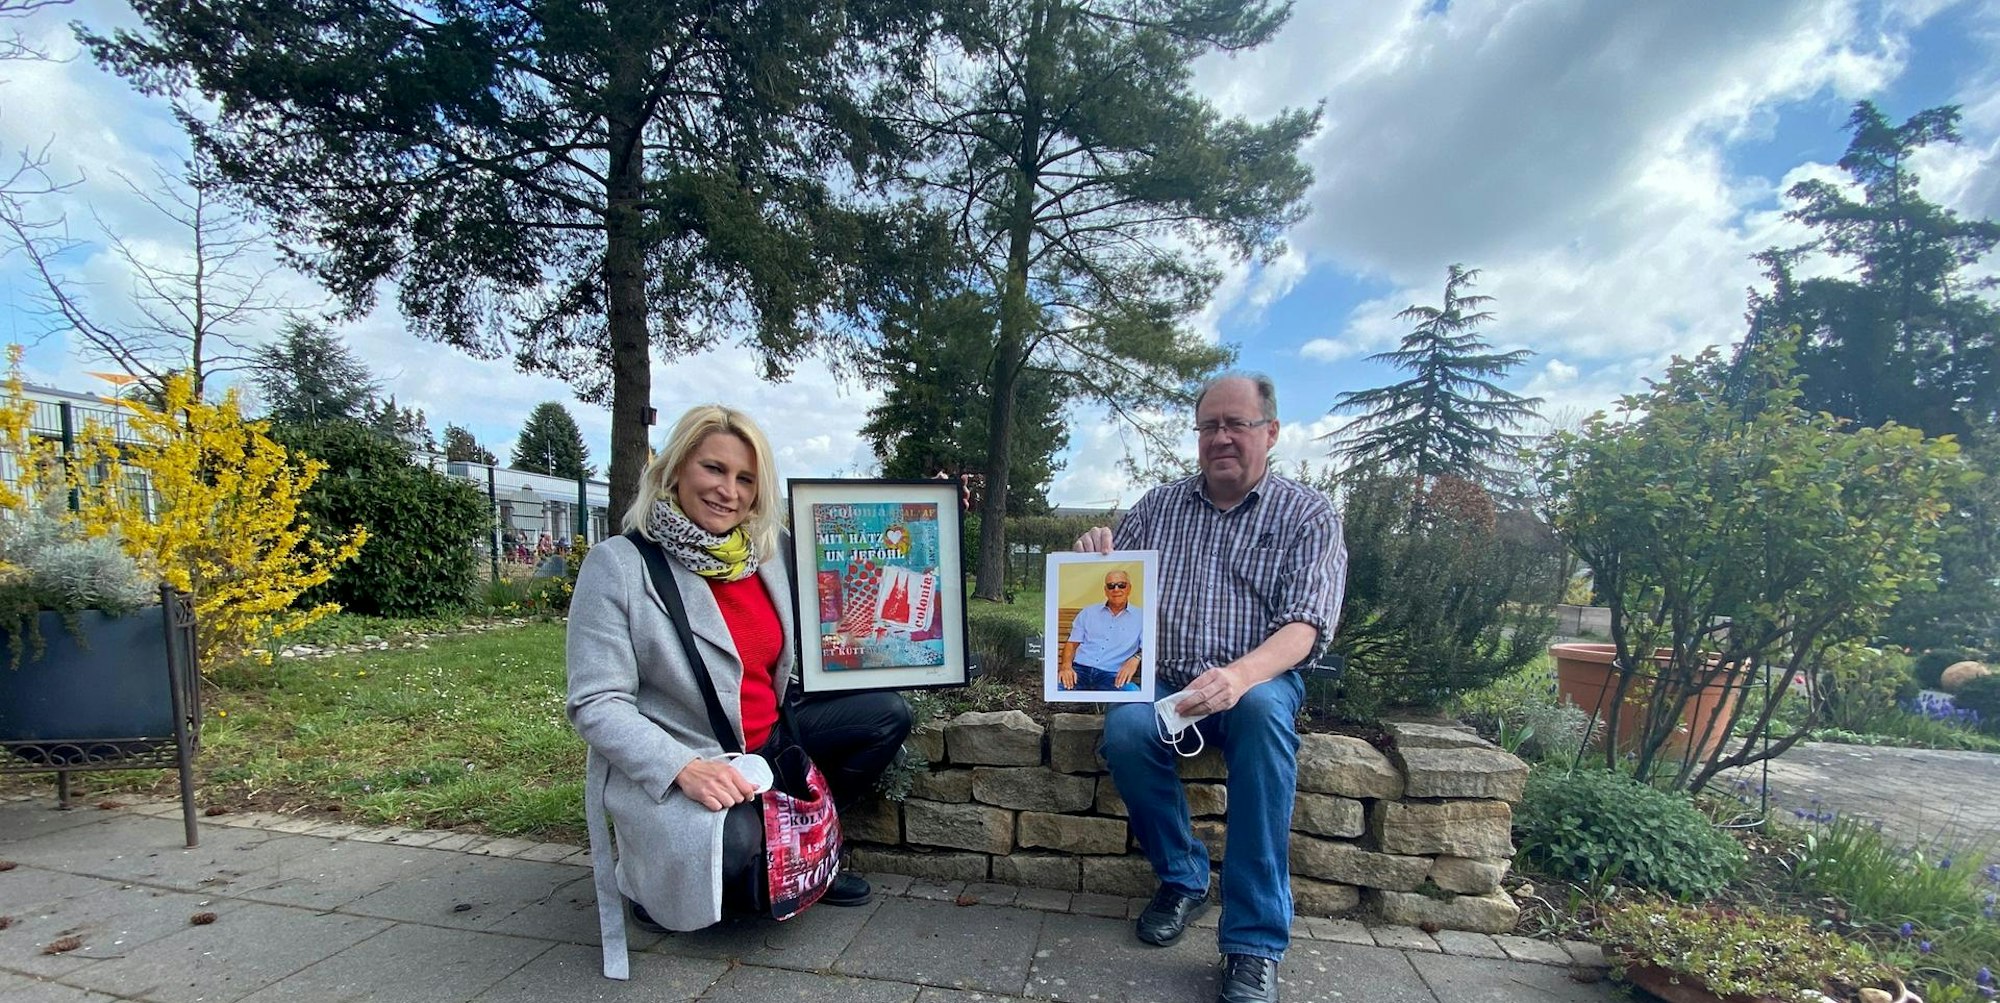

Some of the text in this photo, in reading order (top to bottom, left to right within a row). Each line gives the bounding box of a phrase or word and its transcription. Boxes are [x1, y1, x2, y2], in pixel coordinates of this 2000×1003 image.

[818, 534, 844, 545] MIT
[826, 551, 845, 562] UN
[915, 575, 933, 628] colonia
